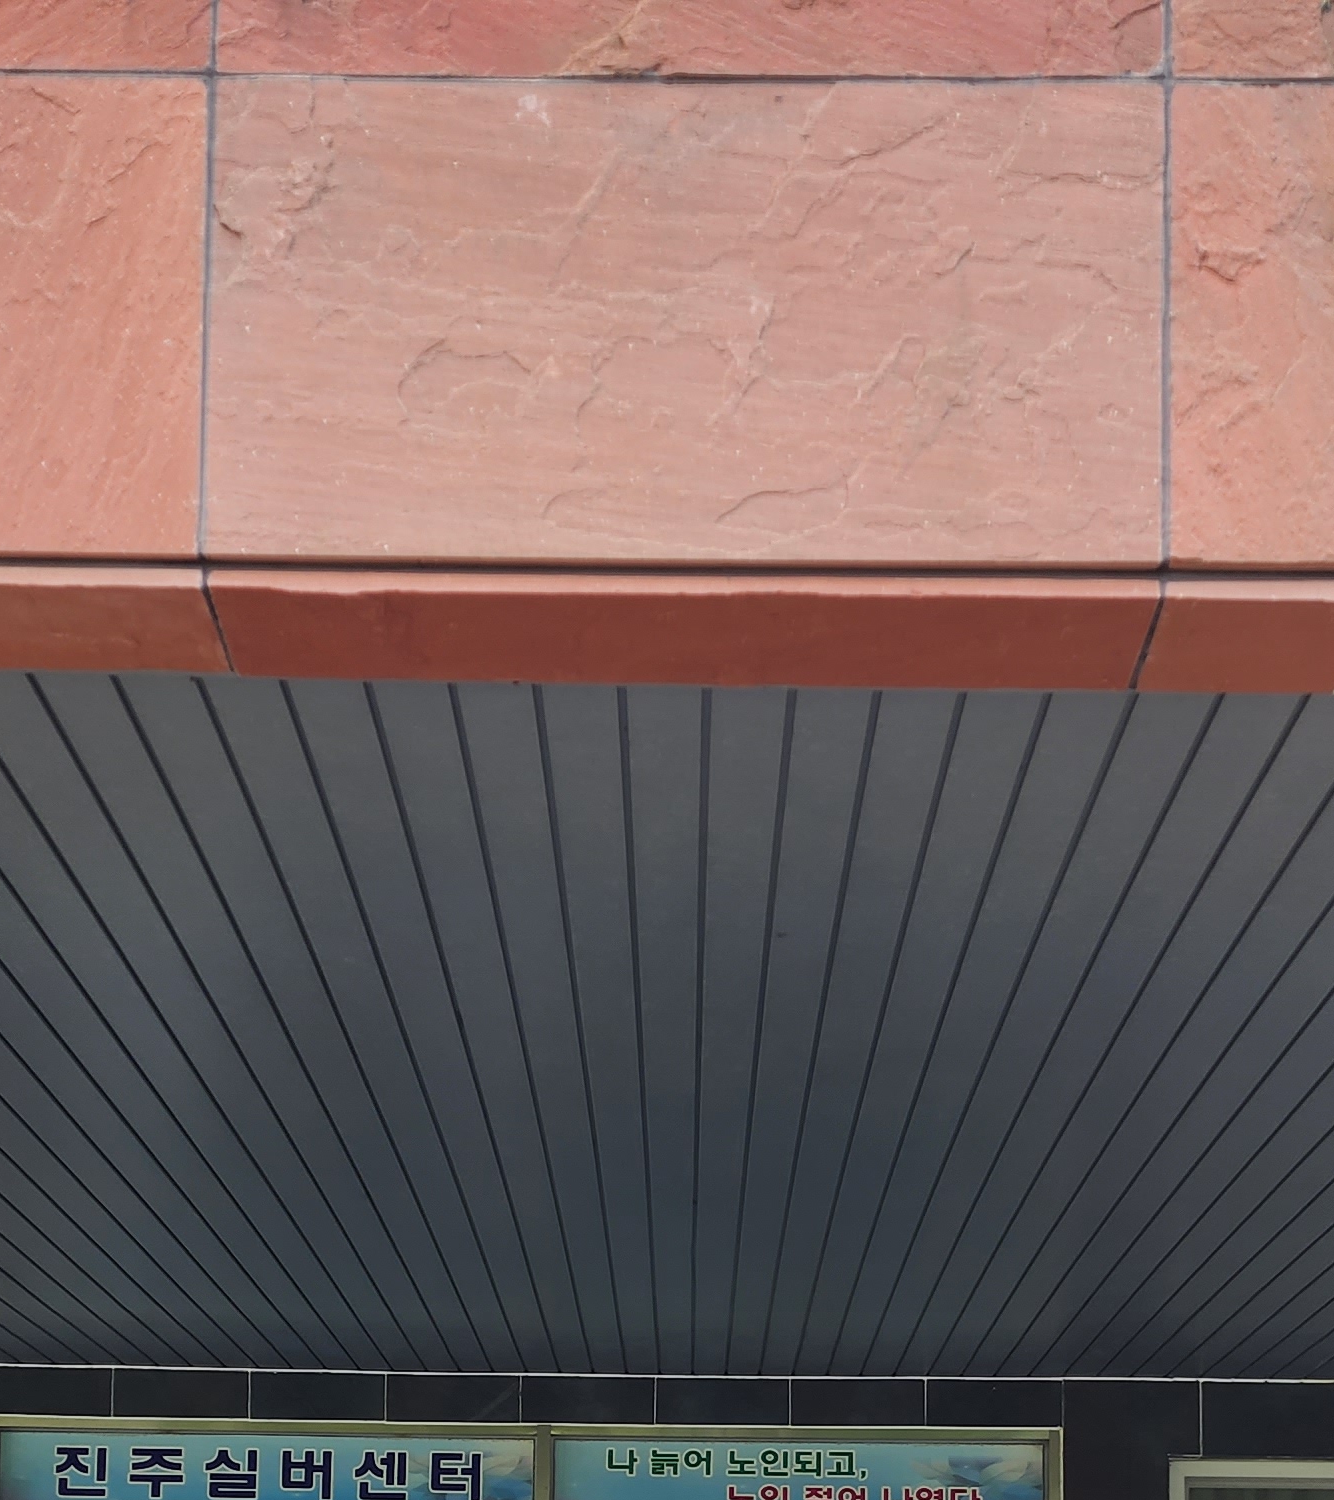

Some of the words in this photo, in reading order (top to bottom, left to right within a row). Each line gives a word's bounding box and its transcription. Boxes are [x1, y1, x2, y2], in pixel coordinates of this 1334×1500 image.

[606, 1448, 639, 1475] 나
[649, 1449, 713, 1476] 늙어
[726, 1449, 868, 1479] 노인되고,
